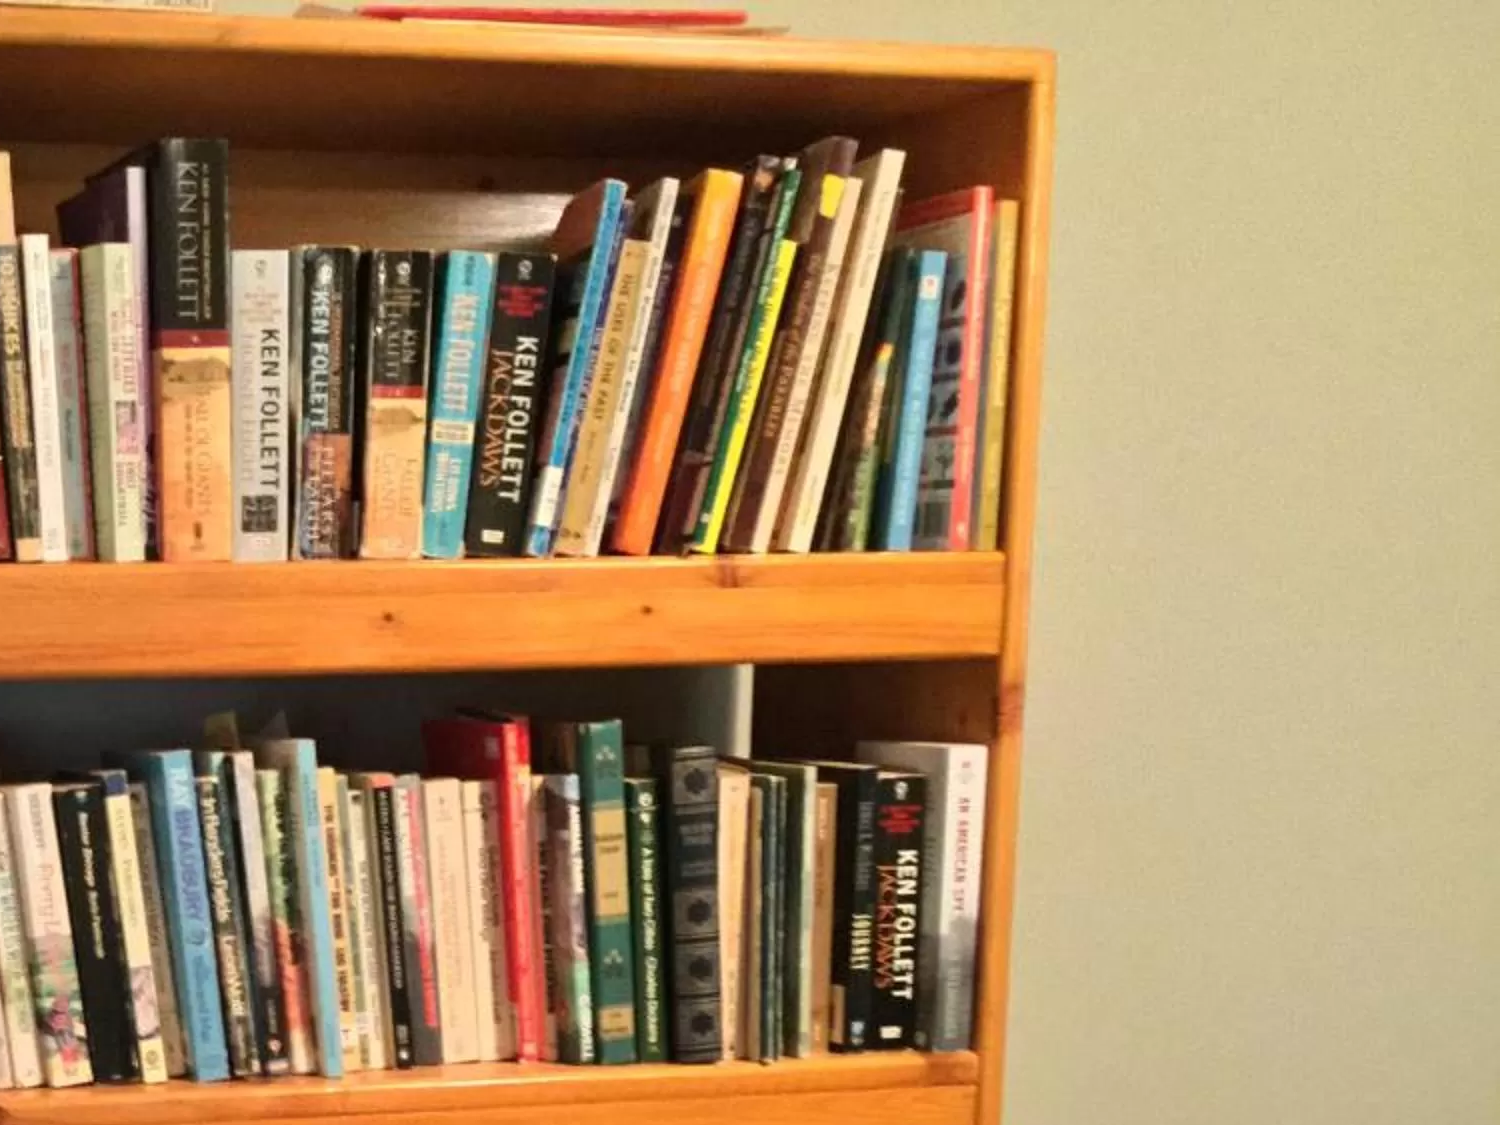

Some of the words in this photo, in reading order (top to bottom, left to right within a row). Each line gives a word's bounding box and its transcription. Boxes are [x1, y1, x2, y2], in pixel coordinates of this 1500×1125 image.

[175, 160, 201, 213] KEN
[176, 220, 201, 322] FOLLETT
[617, 273, 633, 298] THE
[309, 289, 329, 334] KEN
[450, 292, 482, 332] KEN
[611, 302, 629, 332] USES
[258, 328, 281, 378] KEN
[401, 328, 419, 365] KEN
[513, 336, 539, 387] KEN
[608, 337, 623, 355] OF
[308, 342, 329, 431] FOLLETT
[441, 339, 478, 413] FOLLETT
[601, 361, 618, 386] THE
[479, 348, 513, 488] JACKDAWS
[591, 389, 611, 421] PAST
[258, 386, 282, 490] FOLLETT
[499, 394, 533, 504] FOLLETT
[170, 767, 188, 808] RAY
[171, 809, 205, 921] BRADBURY
[640, 846, 650, 857] A
[641, 859, 653, 880] Tale
[896, 850, 919, 896] KEN
[953, 819, 969, 885] AMERICAN
[643, 882, 654, 895] of
[952, 889, 967, 913] SPY
[850, 913, 870, 972] JOURNEY
[874, 864, 896, 989] JACKDAWS
[891, 903, 916, 1000] FOLLETT
